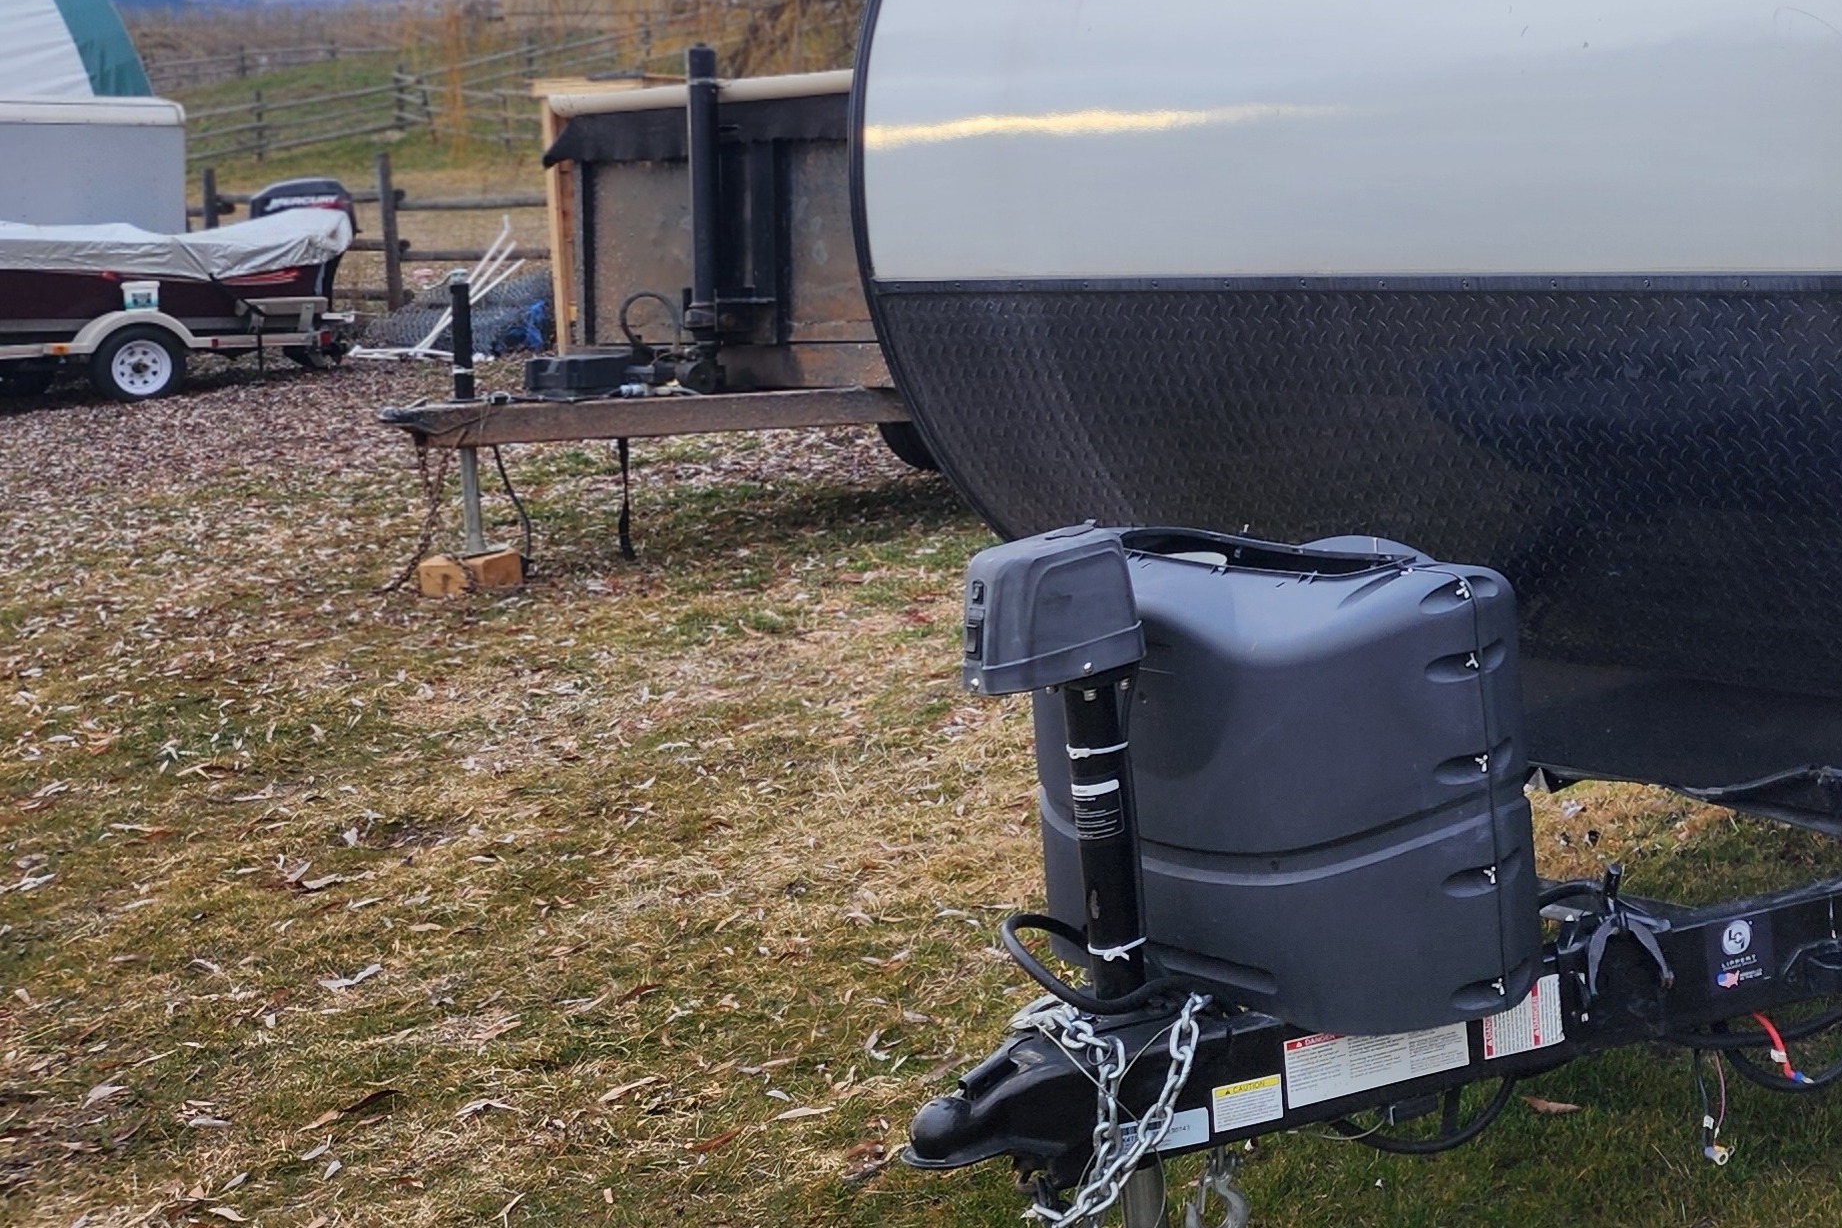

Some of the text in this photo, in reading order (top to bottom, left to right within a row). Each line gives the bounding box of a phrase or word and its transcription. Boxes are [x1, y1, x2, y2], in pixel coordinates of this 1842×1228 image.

[264, 195, 339, 211] MERCURY
[1531, 995, 1540, 1030] DANGER
[1232, 1080, 1266, 1094] CAUTION
